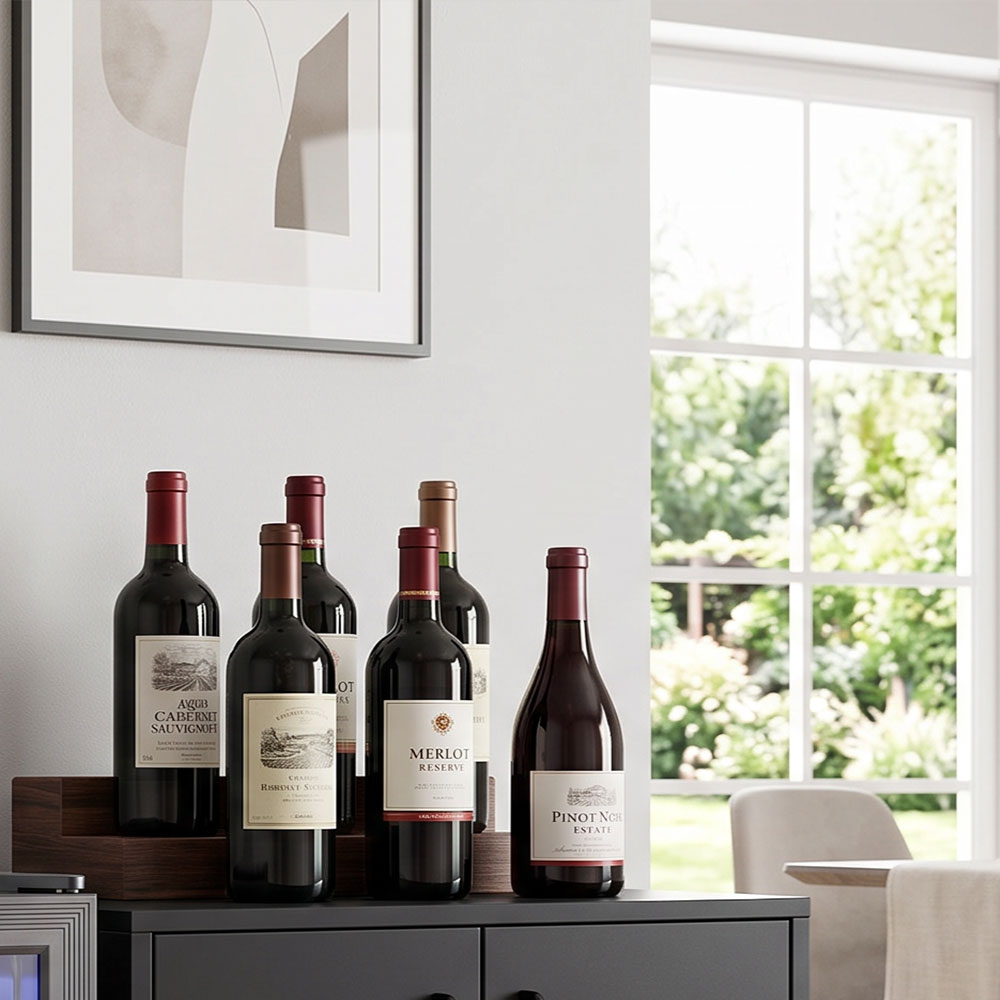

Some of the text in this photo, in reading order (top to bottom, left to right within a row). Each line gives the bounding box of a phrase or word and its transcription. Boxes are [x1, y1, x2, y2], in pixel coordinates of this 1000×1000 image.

[409, 748, 470, 760] MERLOT
[419, 763, 465, 772] RESERVE
[552, 811, 597, 823] PINOT
[573, 826, 612, 834] ESTATE
